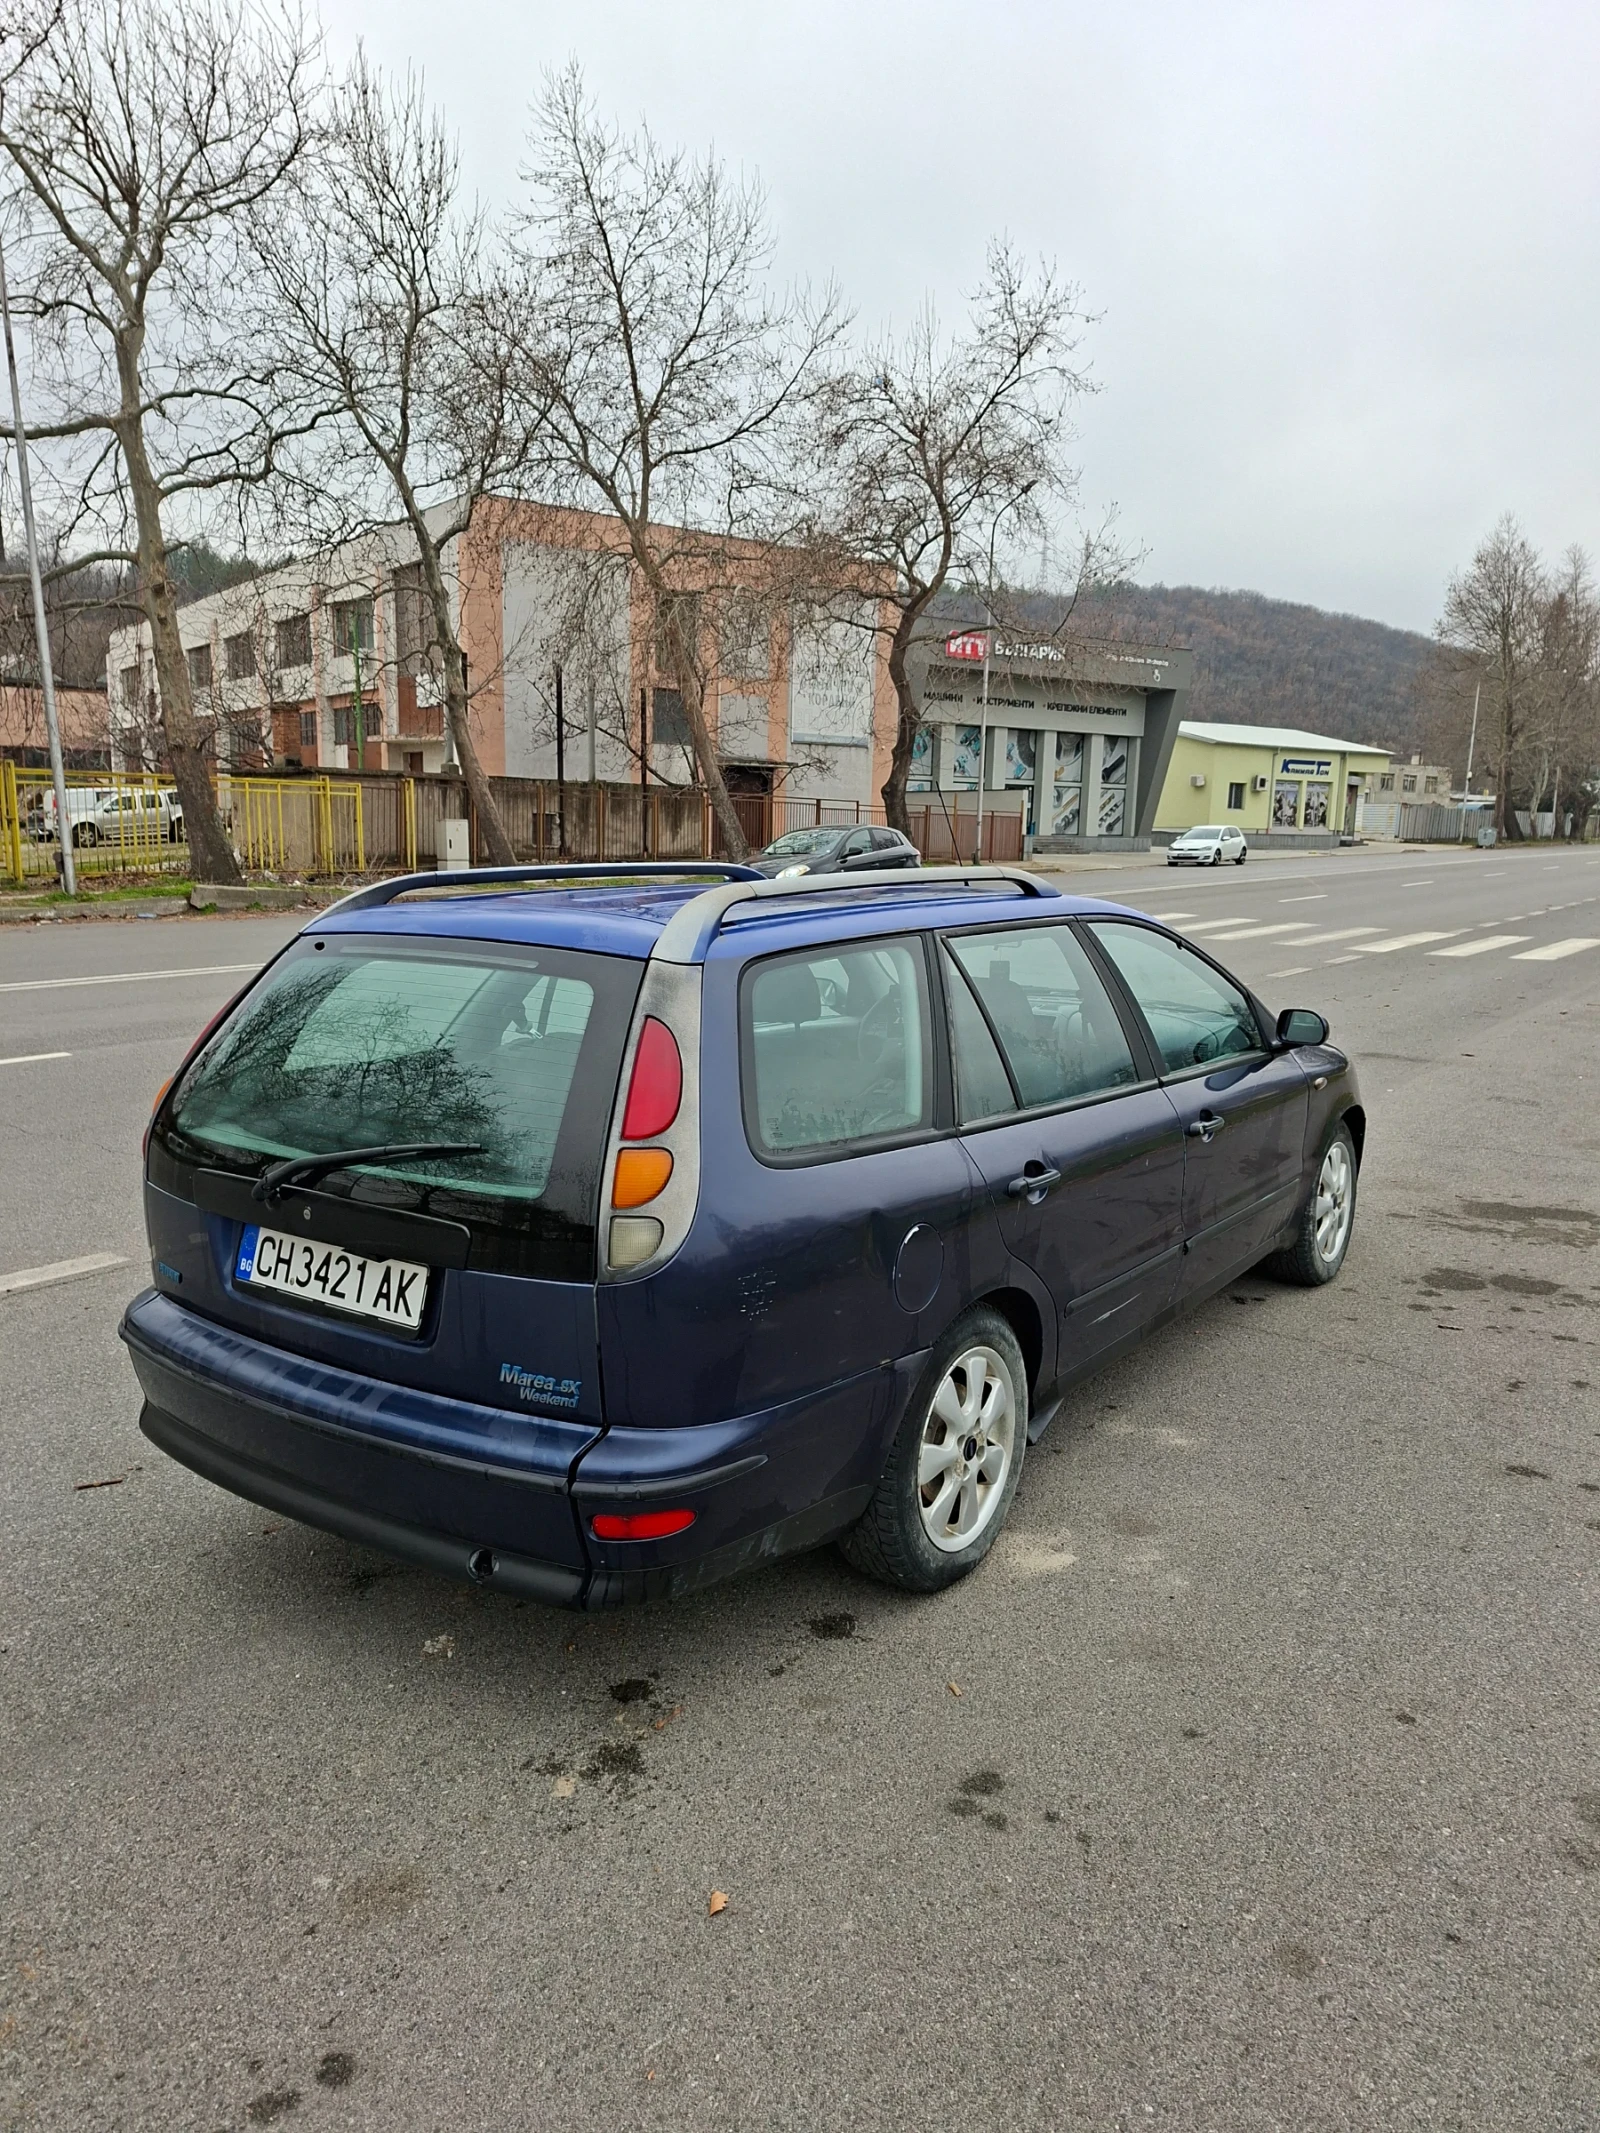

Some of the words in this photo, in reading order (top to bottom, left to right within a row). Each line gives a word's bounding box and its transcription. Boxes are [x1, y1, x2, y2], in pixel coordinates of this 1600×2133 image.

[923, 691, 963, 703] МАШИНИ
[1046, 702, 1088, 714] КРЕПЕЖНИ
[1089, 705, 1127, 717] ЕЛЕМЕНТИ
[240, 1257, 252, 1272] BG
[500, 1363, 556, 1391] Marea
[519, 1386, 580, 1409] Weekend
